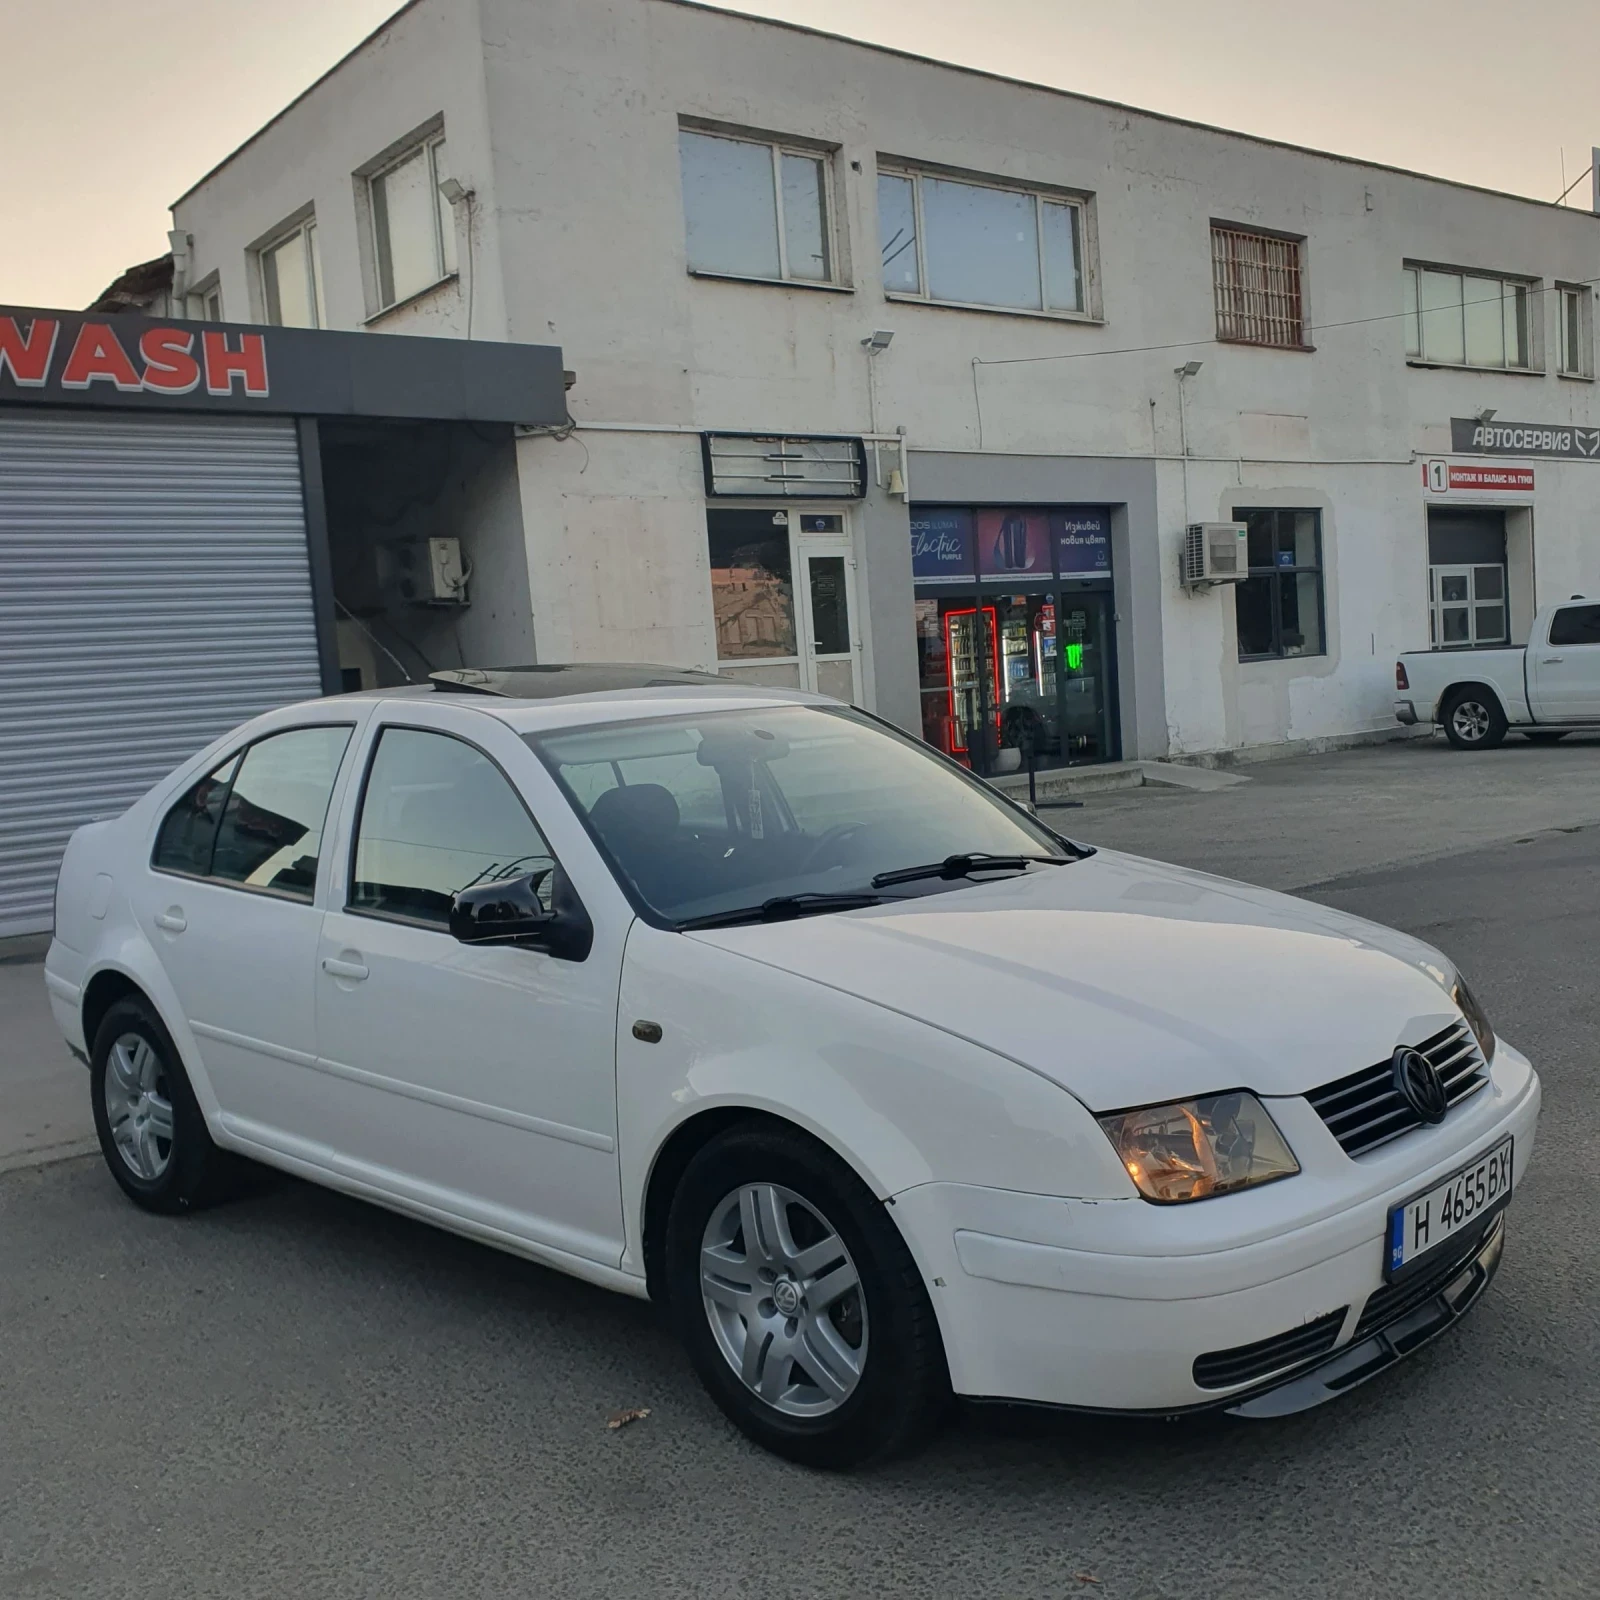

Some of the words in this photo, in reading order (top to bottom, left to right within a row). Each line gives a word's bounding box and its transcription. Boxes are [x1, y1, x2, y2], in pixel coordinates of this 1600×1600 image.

[1472, 427, 1571, 451] АВТОСЕРВИЗ
[1434, 465, 1442, 487] 1
[1450, 472, 1477, 482] МОНТАЖ
[1483, 473, 1507, 483] БАЛАНС
[1508, 475, 1517, 484] НА
[1065, 520, 1101, 534] Изживей
[1060, 535, 1084, 545] новия
[1084, 534, 1106, 546] цвят
[941, 553, 962, 561] PURPLE
[1414, 1200, 1430, 1250] H
[1440, 1165, 1486, 1230] 4655
[1488, 1146, 1509, 1200] BX
